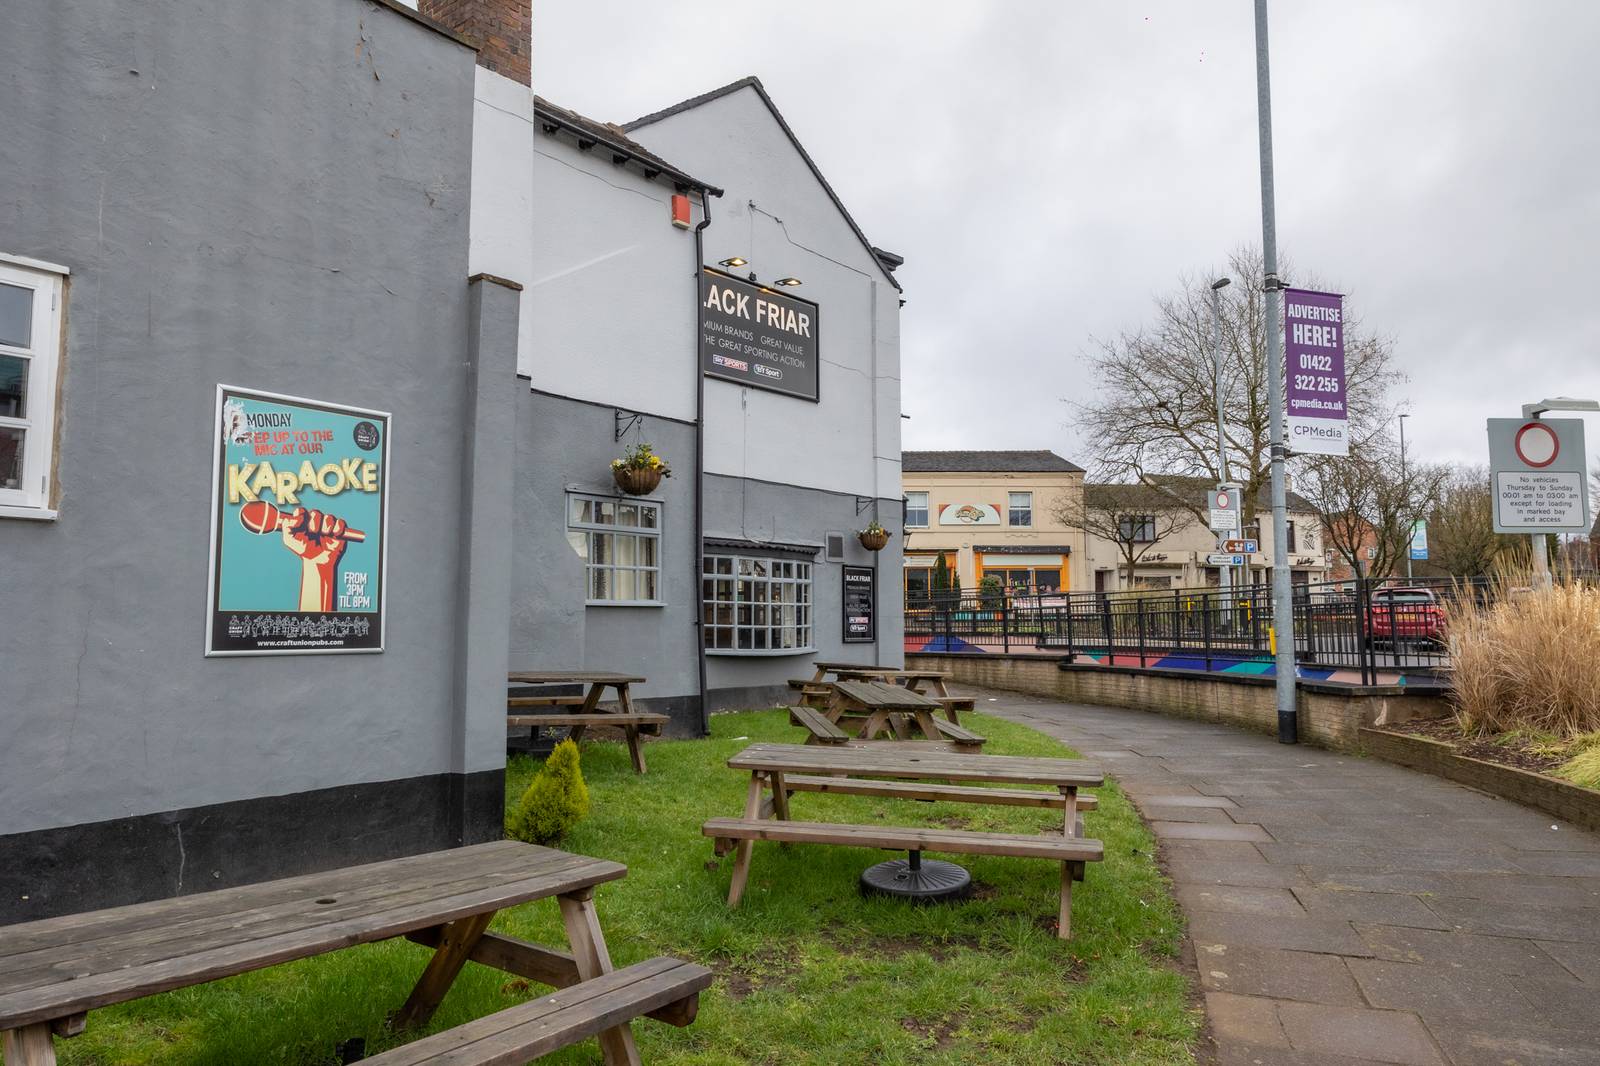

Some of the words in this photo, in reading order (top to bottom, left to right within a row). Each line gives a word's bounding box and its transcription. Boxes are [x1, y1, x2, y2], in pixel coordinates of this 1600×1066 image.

[703, 284, 750, 320] ACK
[756, 299, 811, 338] FRIAR
[1288, 303, 1341, 322] ADVERTISE
[724, 325, 754, 342] BRANDS
[760, 335, 782, 350] GREAT
[783, 342, 804, 356] VALUE
[1293, 323, 1337, 348] HERE!
[718, 338, 742, 352] GREAT
[743, 345, 779, 362] SPORTING
[780, 357, 806, 369] ACTION
[1300, 354, 1332, 371] 01422
[1294, 374, 1316, 391] 322
[1317, 376, 1339, 392] 255
[1291, 399, 1344, 411] cpmedia.co.uk
[246, 413, 292, 428] MONDAY
[272, 431, 289, 443] UP
[291, 431, 309, 442] TO
[311, 430, 334, 441] THE
[1294, 425, 1343, 438] CPMedia
[254, 443, 278, 457] MIC
[280, 443, 295, 455] AT
[298, 442, 323, 455] OUR
[227, 457, 379, 505] KARAOKE
[1506, 484, 1536, 492] Thursday
[1549, 484, 1573, 492] Sunday
[1510, 500, 1532, 508] except
[1548, 500, 1573, 508] loading
[1554, 508, 1566, 516] bay
[344, 571, 367, 585] FROM
[346, 583, 365, 596] 3PM
[340, 595, 352, 608] TIL
[257, 639, 344, 648] www.craftunionpubs.com
